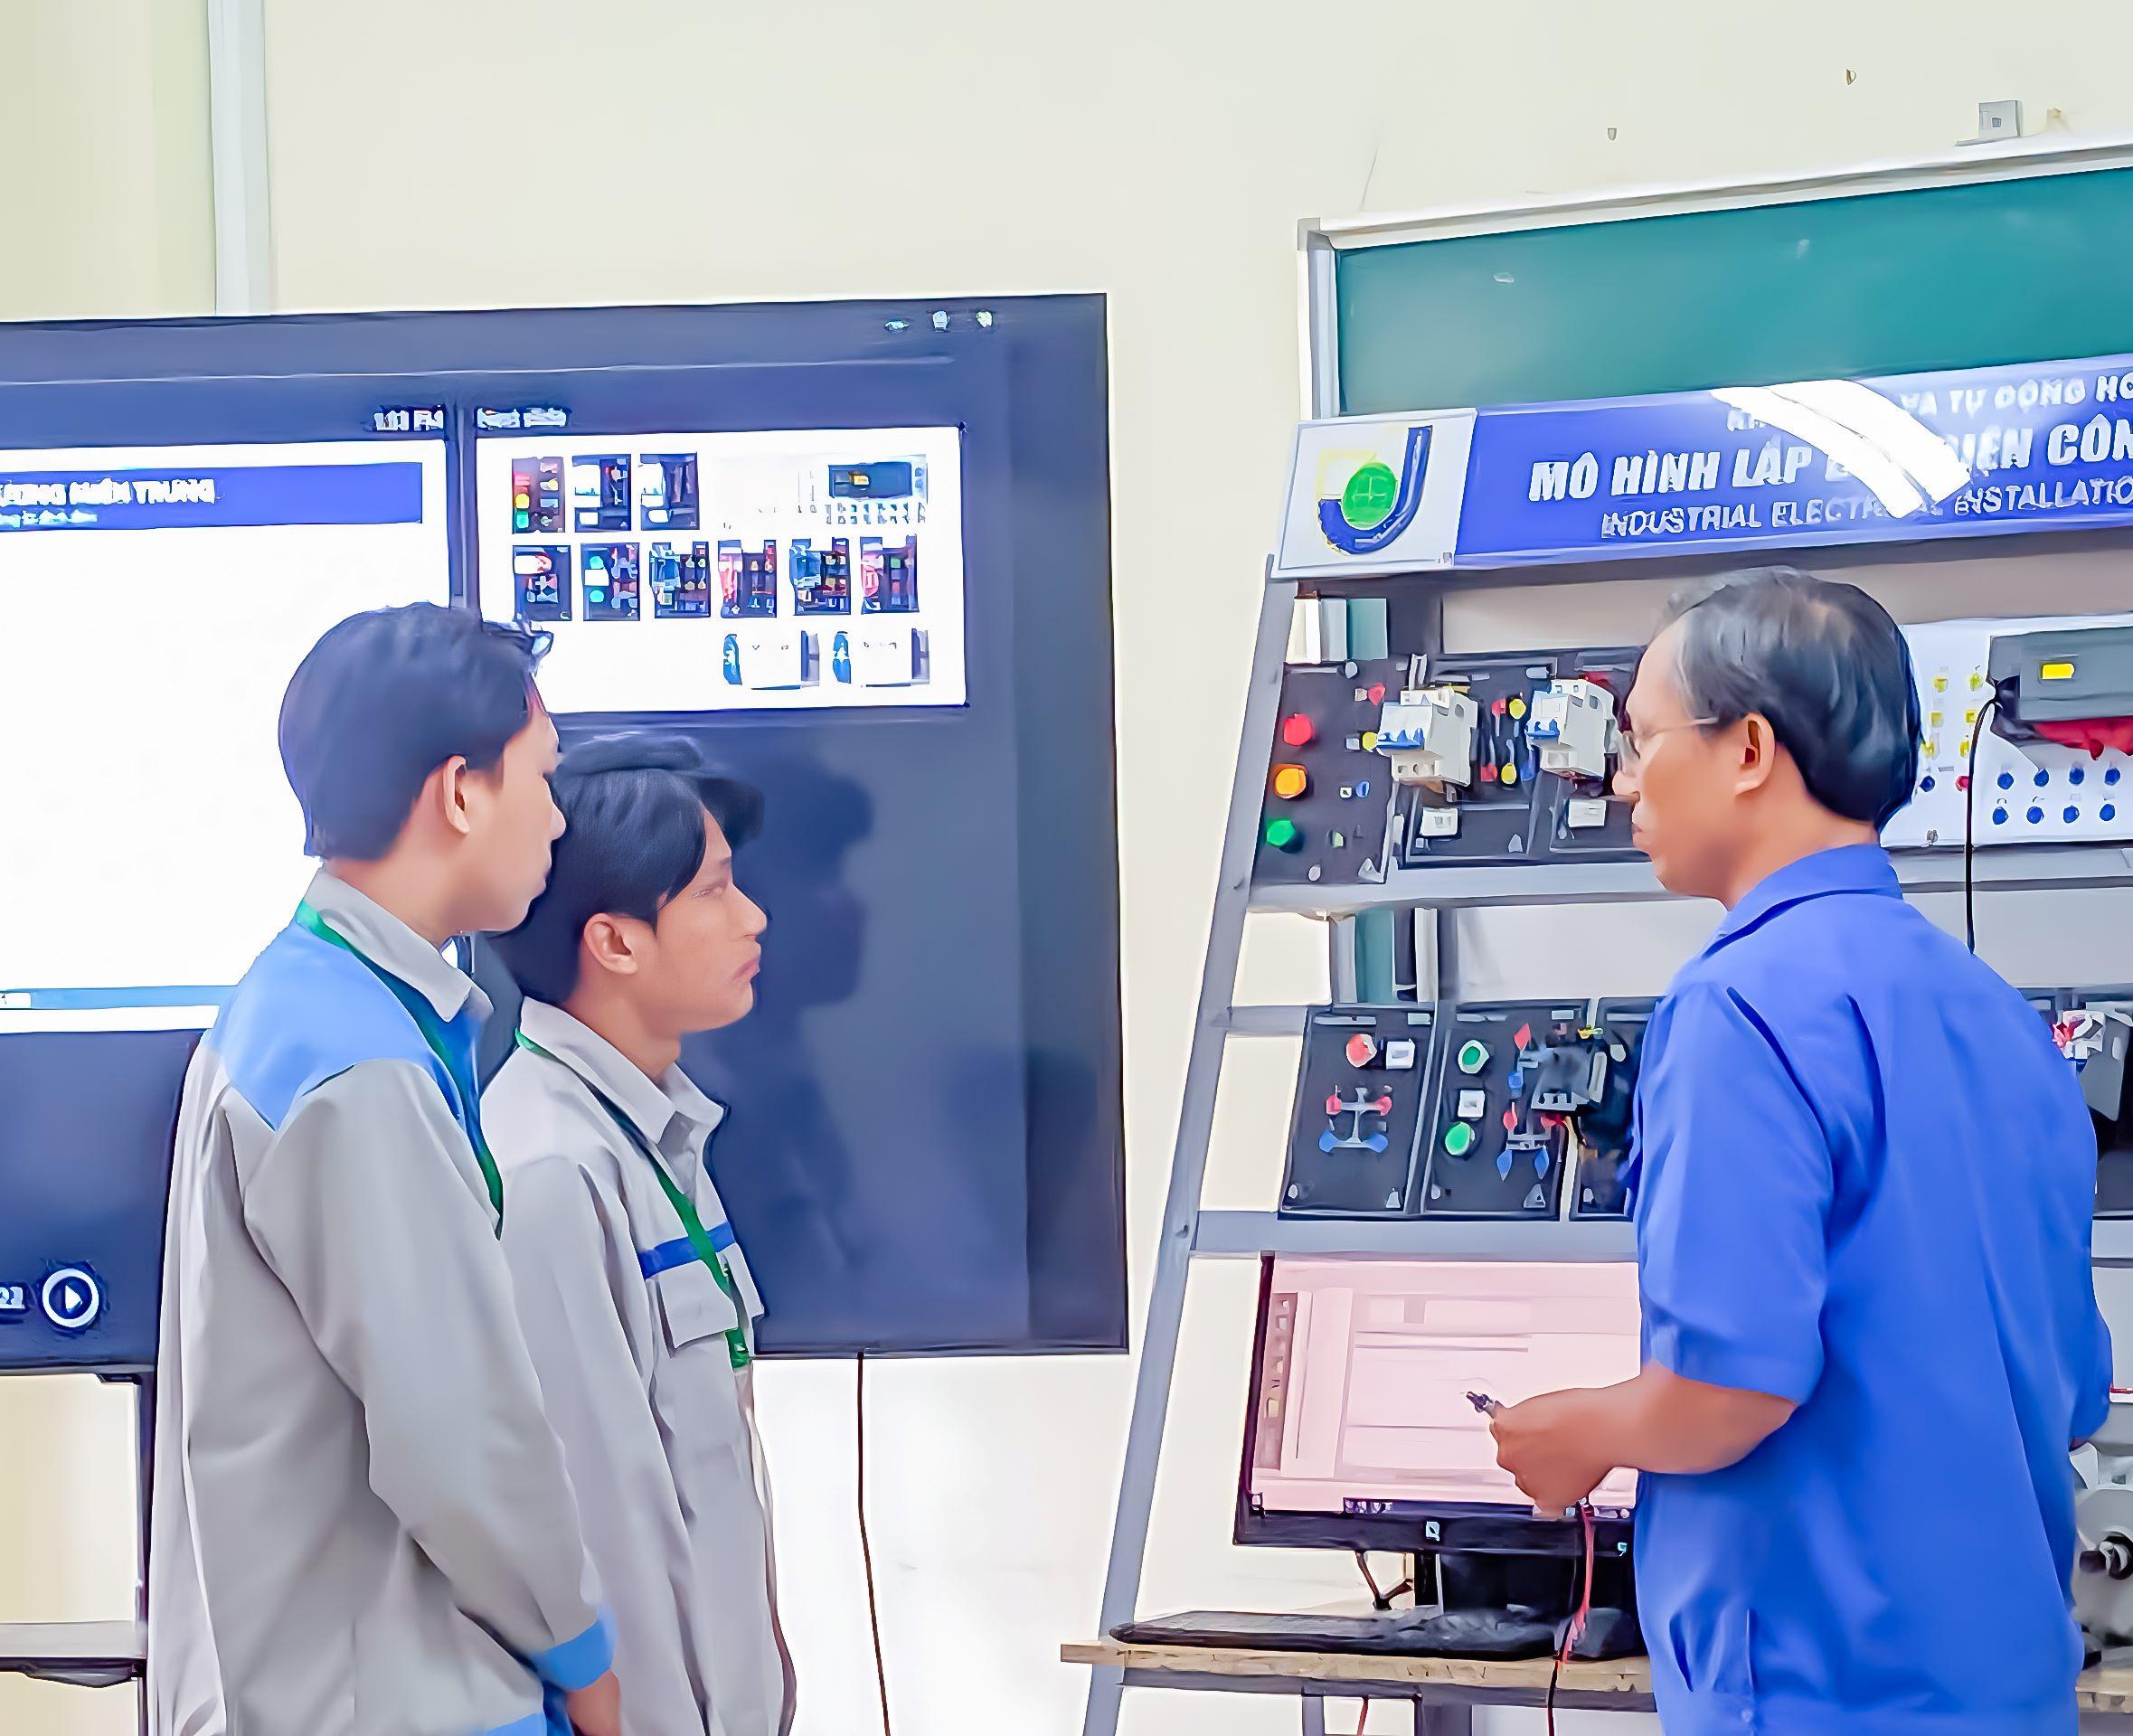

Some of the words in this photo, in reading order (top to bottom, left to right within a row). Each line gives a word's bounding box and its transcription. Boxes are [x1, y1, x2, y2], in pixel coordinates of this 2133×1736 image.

[1528, 452, 1599, 502] MÔ
[1611, 449, 1721, 495] HÌNH
[1601, 504, 1762, 539] INDUSTRIAL
